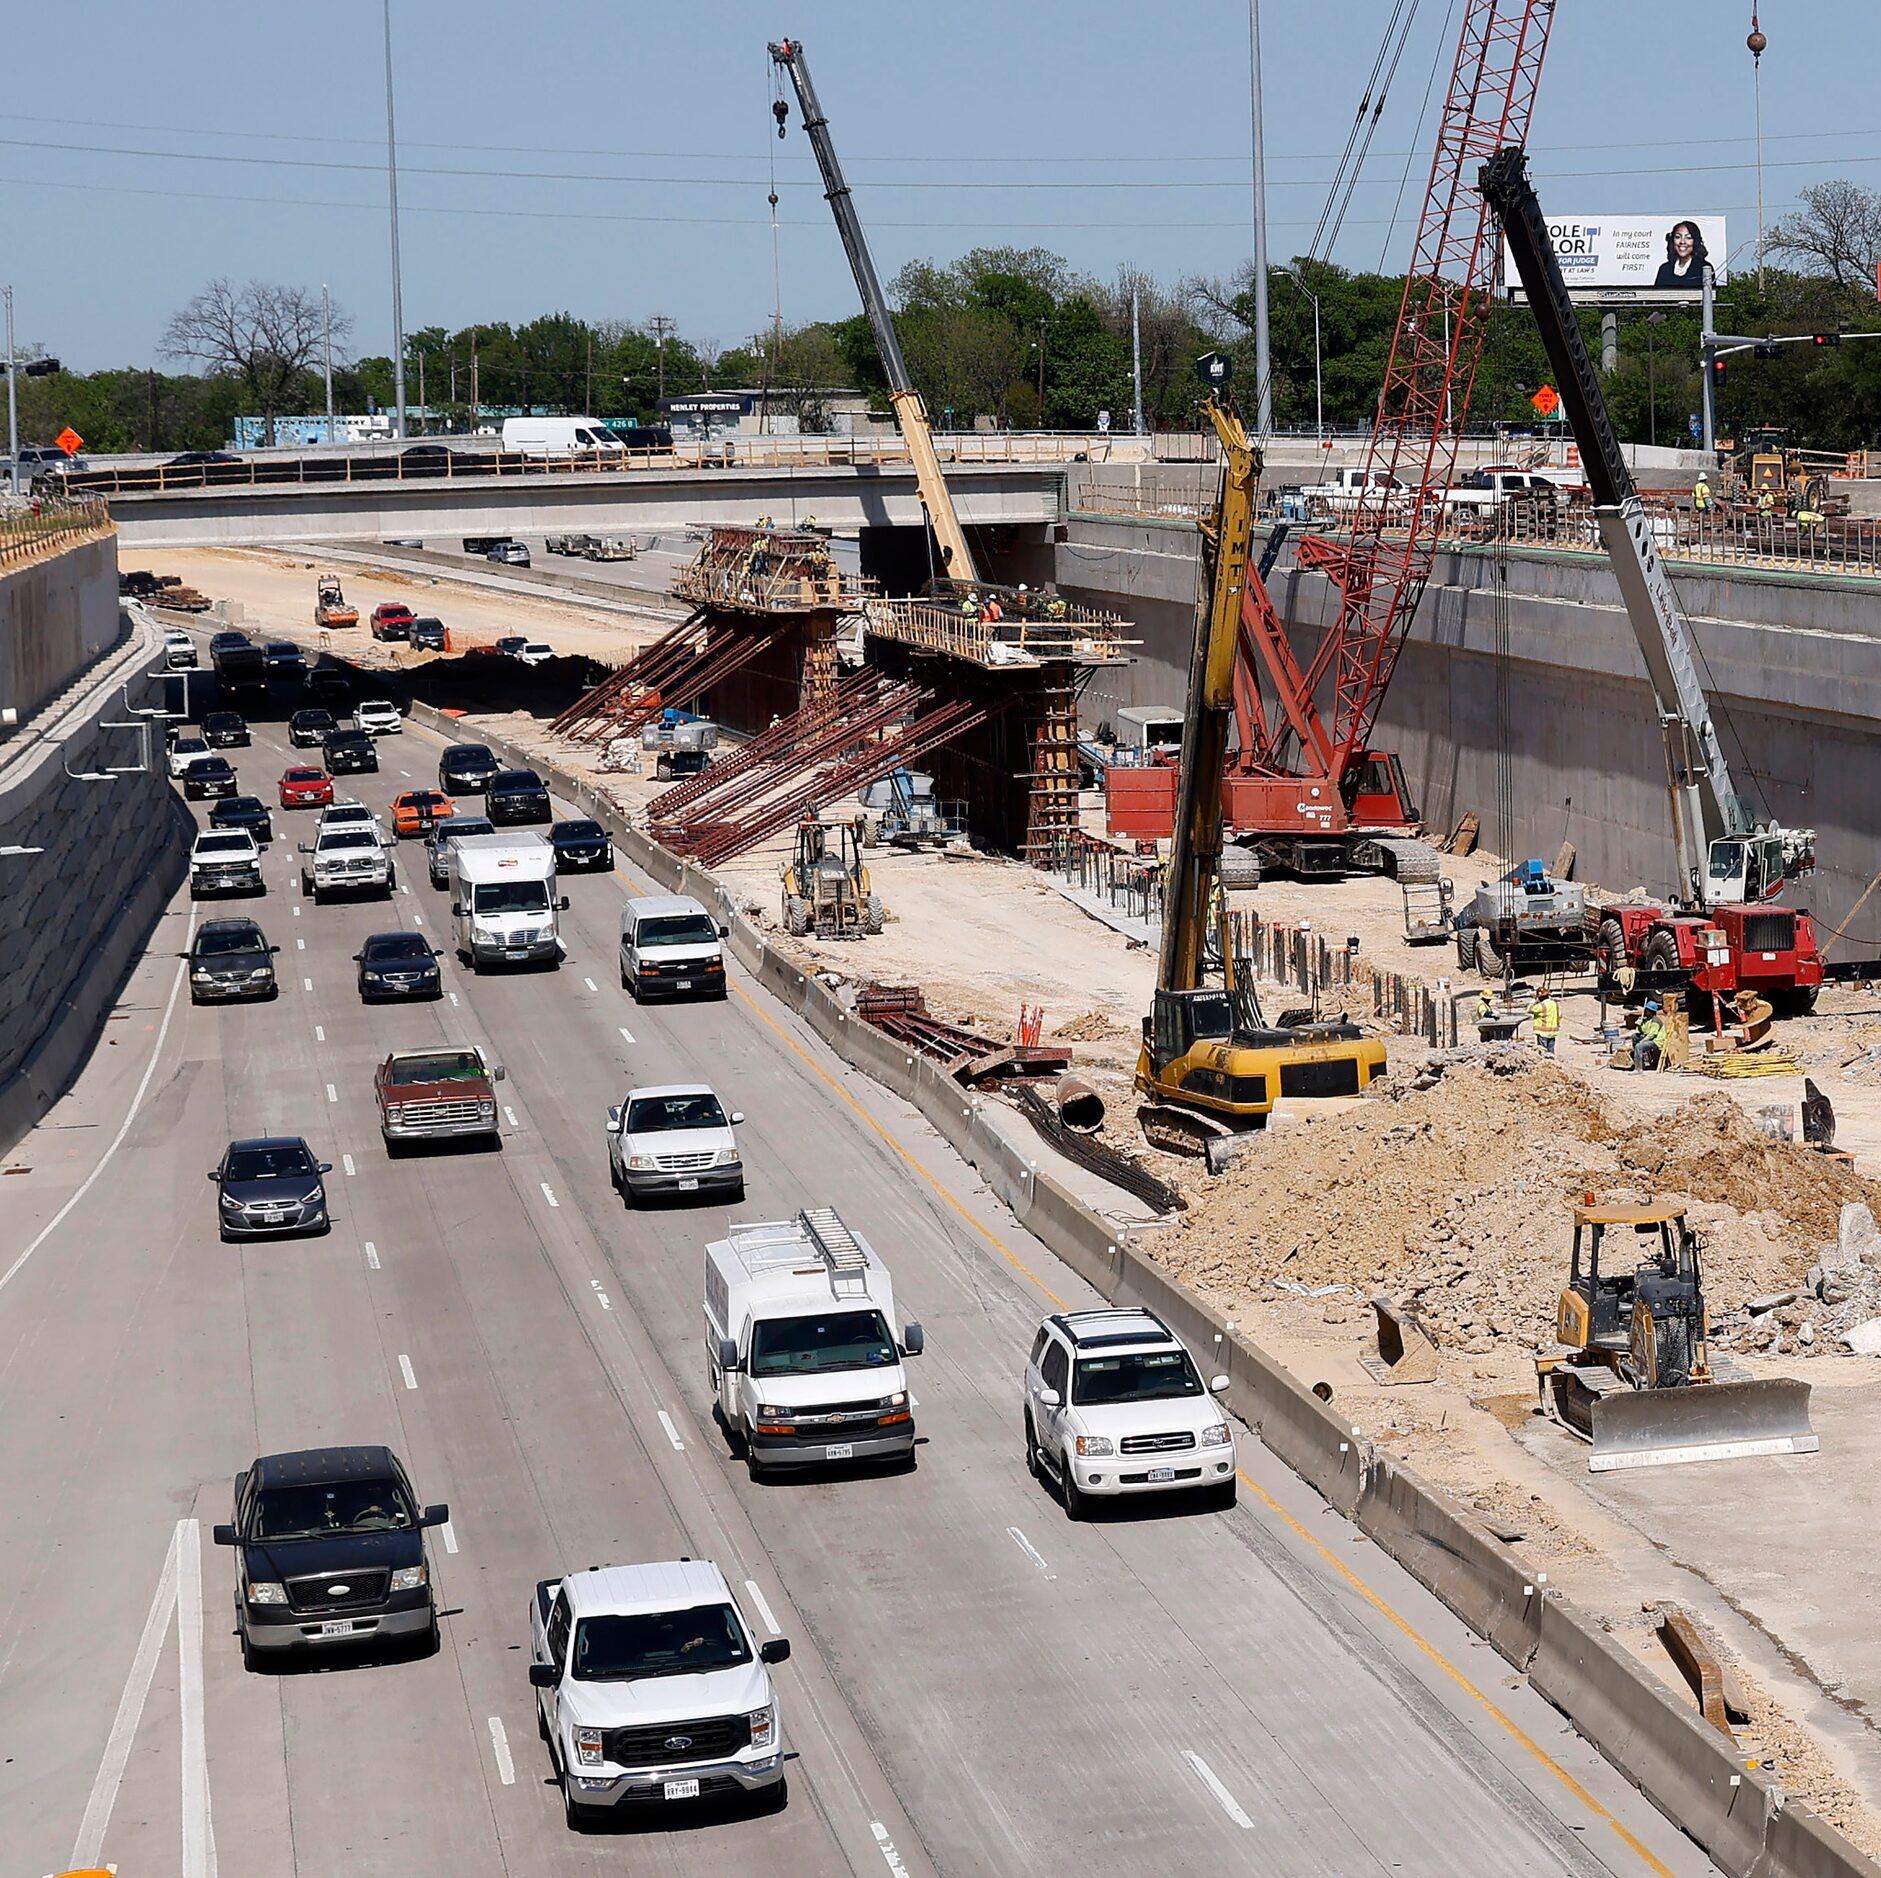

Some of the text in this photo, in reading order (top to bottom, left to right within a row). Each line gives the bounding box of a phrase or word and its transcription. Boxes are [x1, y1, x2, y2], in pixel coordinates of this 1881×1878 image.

[1546, 225, 1581, 238] OLE
[1615, 241, 1650, 249] FAIRNESS
[1573, 257, 1595, 266] JUDGE
[669, 402, 741, 412] HENLEY PROPERTIES
